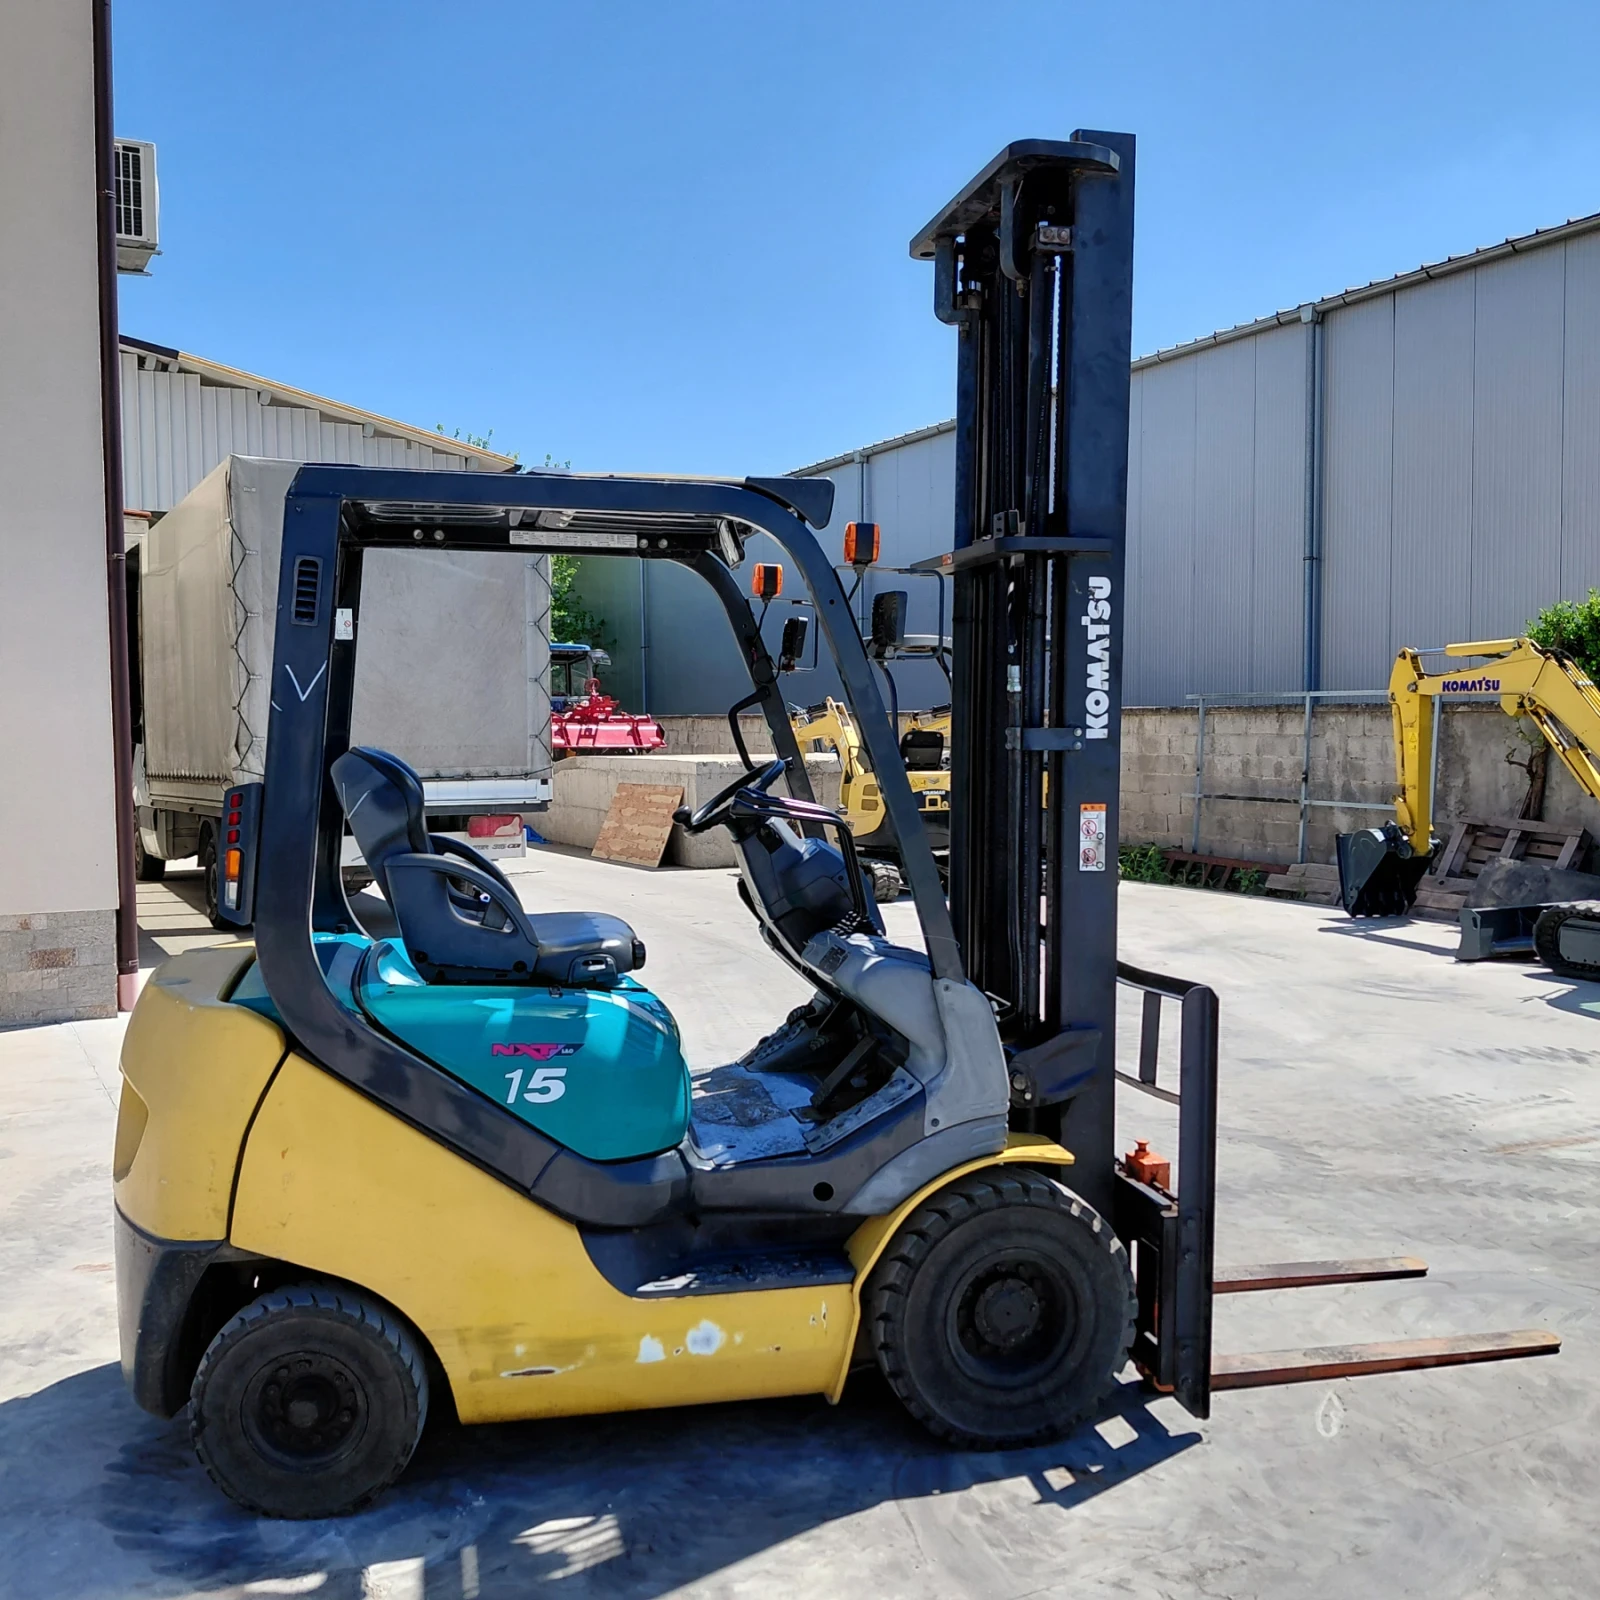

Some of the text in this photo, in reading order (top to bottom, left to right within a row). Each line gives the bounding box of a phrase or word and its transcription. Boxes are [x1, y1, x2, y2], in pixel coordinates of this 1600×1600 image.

[1081, 576, 1112, 739] KOMATSU
[1442, 677, 1500, 692] KOMATSU
[492, 1043, 559, 1060] NXT
[505, 1067, 567, 1104] 15
